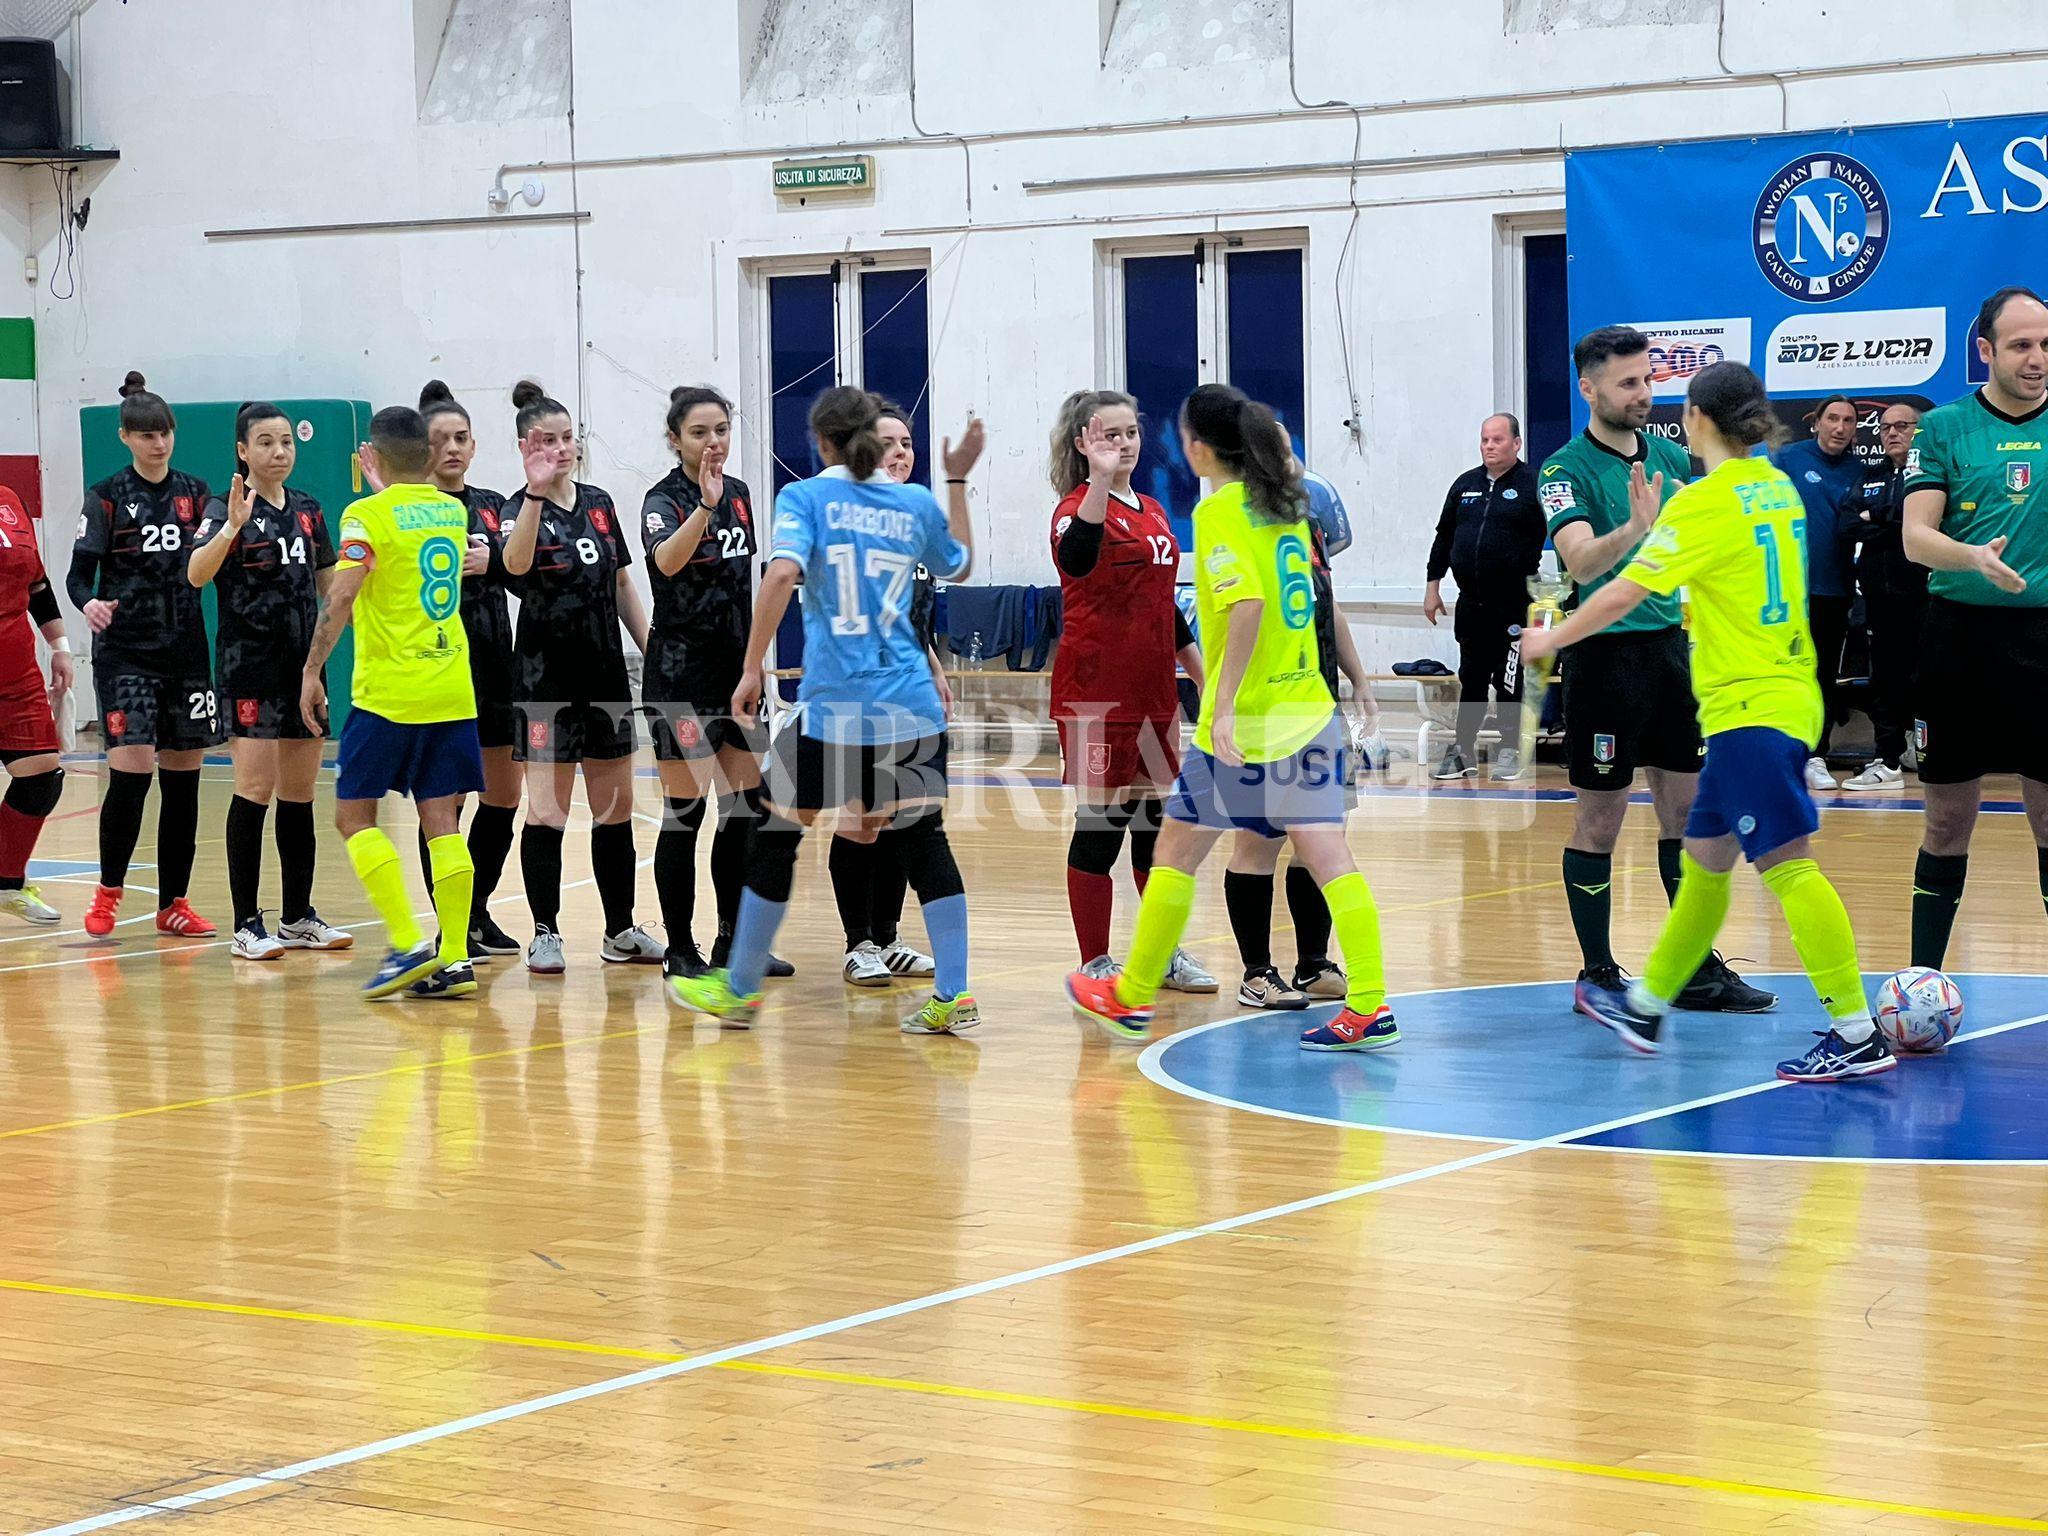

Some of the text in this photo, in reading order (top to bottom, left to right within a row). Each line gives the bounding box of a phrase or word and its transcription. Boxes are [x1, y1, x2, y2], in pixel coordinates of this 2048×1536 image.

[775, 167, 862, 184] USCITA DI SICUREZZA
[1764, 163, 1879, 215] WOMAN NAPOLI
[1765, 251, 1803, 291] CALCIO
[1835, 244, 1875, 288] CINQUE
[1681, 327, 1725, 336] RICAMBI
[1779, 334, 1818, 343] GRUPPO
[1798, 337, 1933, 363] DE LUCIA
[1816, 358, 1930, 369] AZIENDA EDILE STRADALE
[1996, 442, 2042, 451] LEGEA
[141, 524, 181, 553] 28
[277, 537, 306, 565] 14
[575, 538, 599, 565] 8
[717, 526, 749, 558] 22
[1147, 535, 1173, 565] 12
[418, 536, 460, 621] 8
[825, 543, 914, 639] 17
[1276, 535, 1315, 630] 6
[1504, 640, 1521, 695] LEGEA
[188, 691, 216, 720] 28
